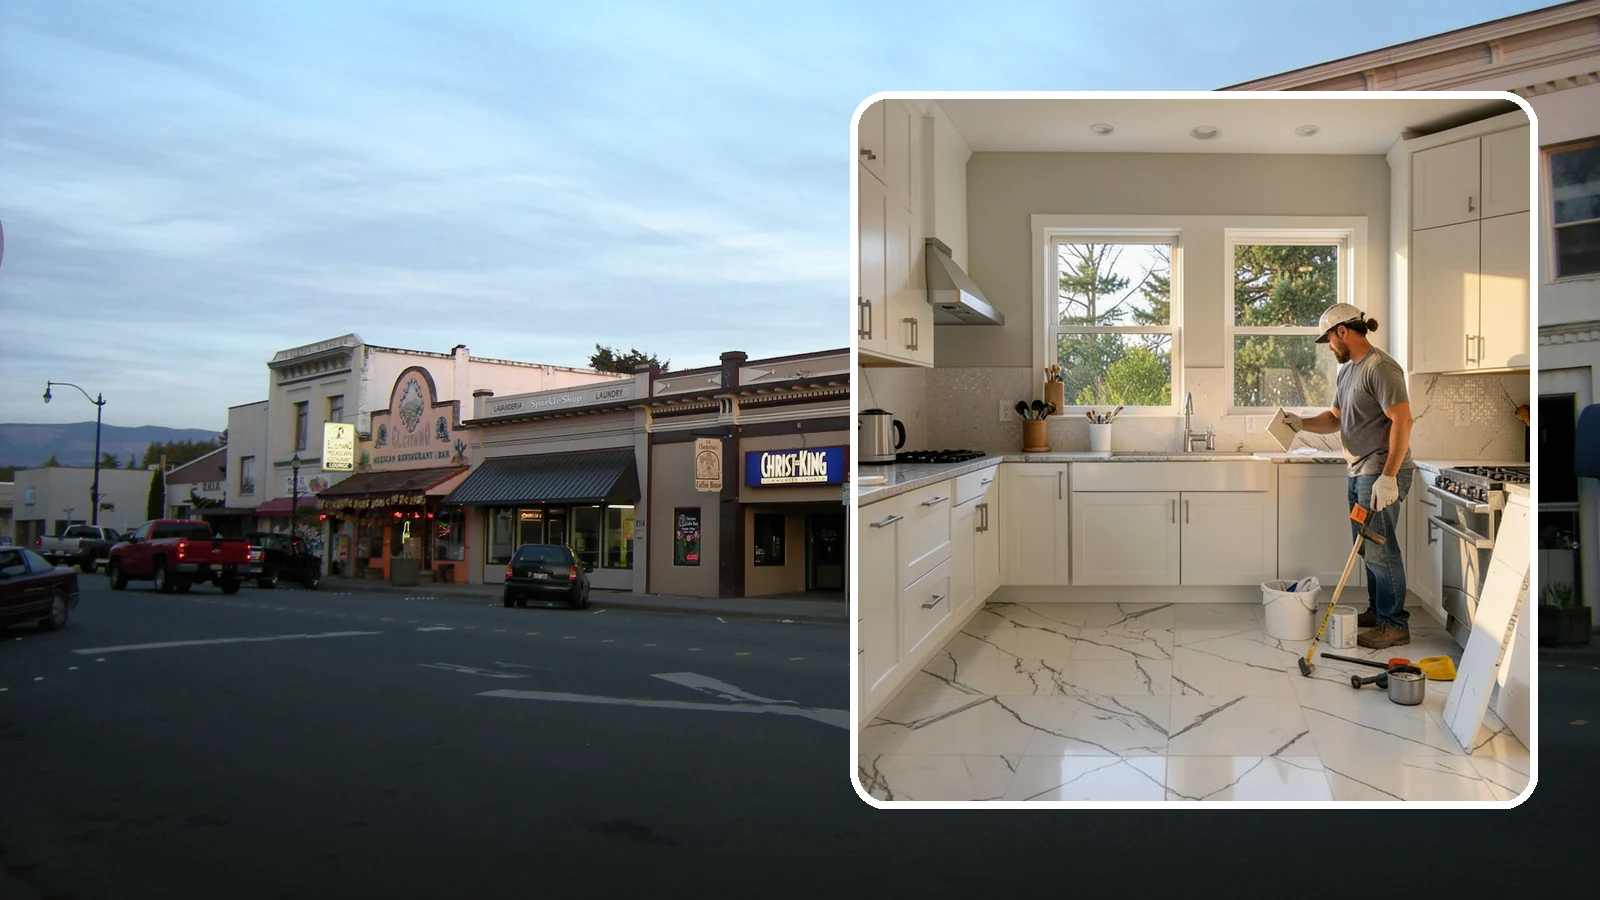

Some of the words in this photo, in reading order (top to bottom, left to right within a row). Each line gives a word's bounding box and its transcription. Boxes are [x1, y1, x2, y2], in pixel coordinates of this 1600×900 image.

[595, 389, 623, 400] LAUNDRY
[493, 402, 522, 413] LAVANDERIA
[373, 456, 396, 465] MEXICAN
[397, 452, 433, 462] RESTAURANT
[438, 451, 450, 460] BAR
[696, 481, 709, 489] Coffee
[710, 481, 721, 489] House
